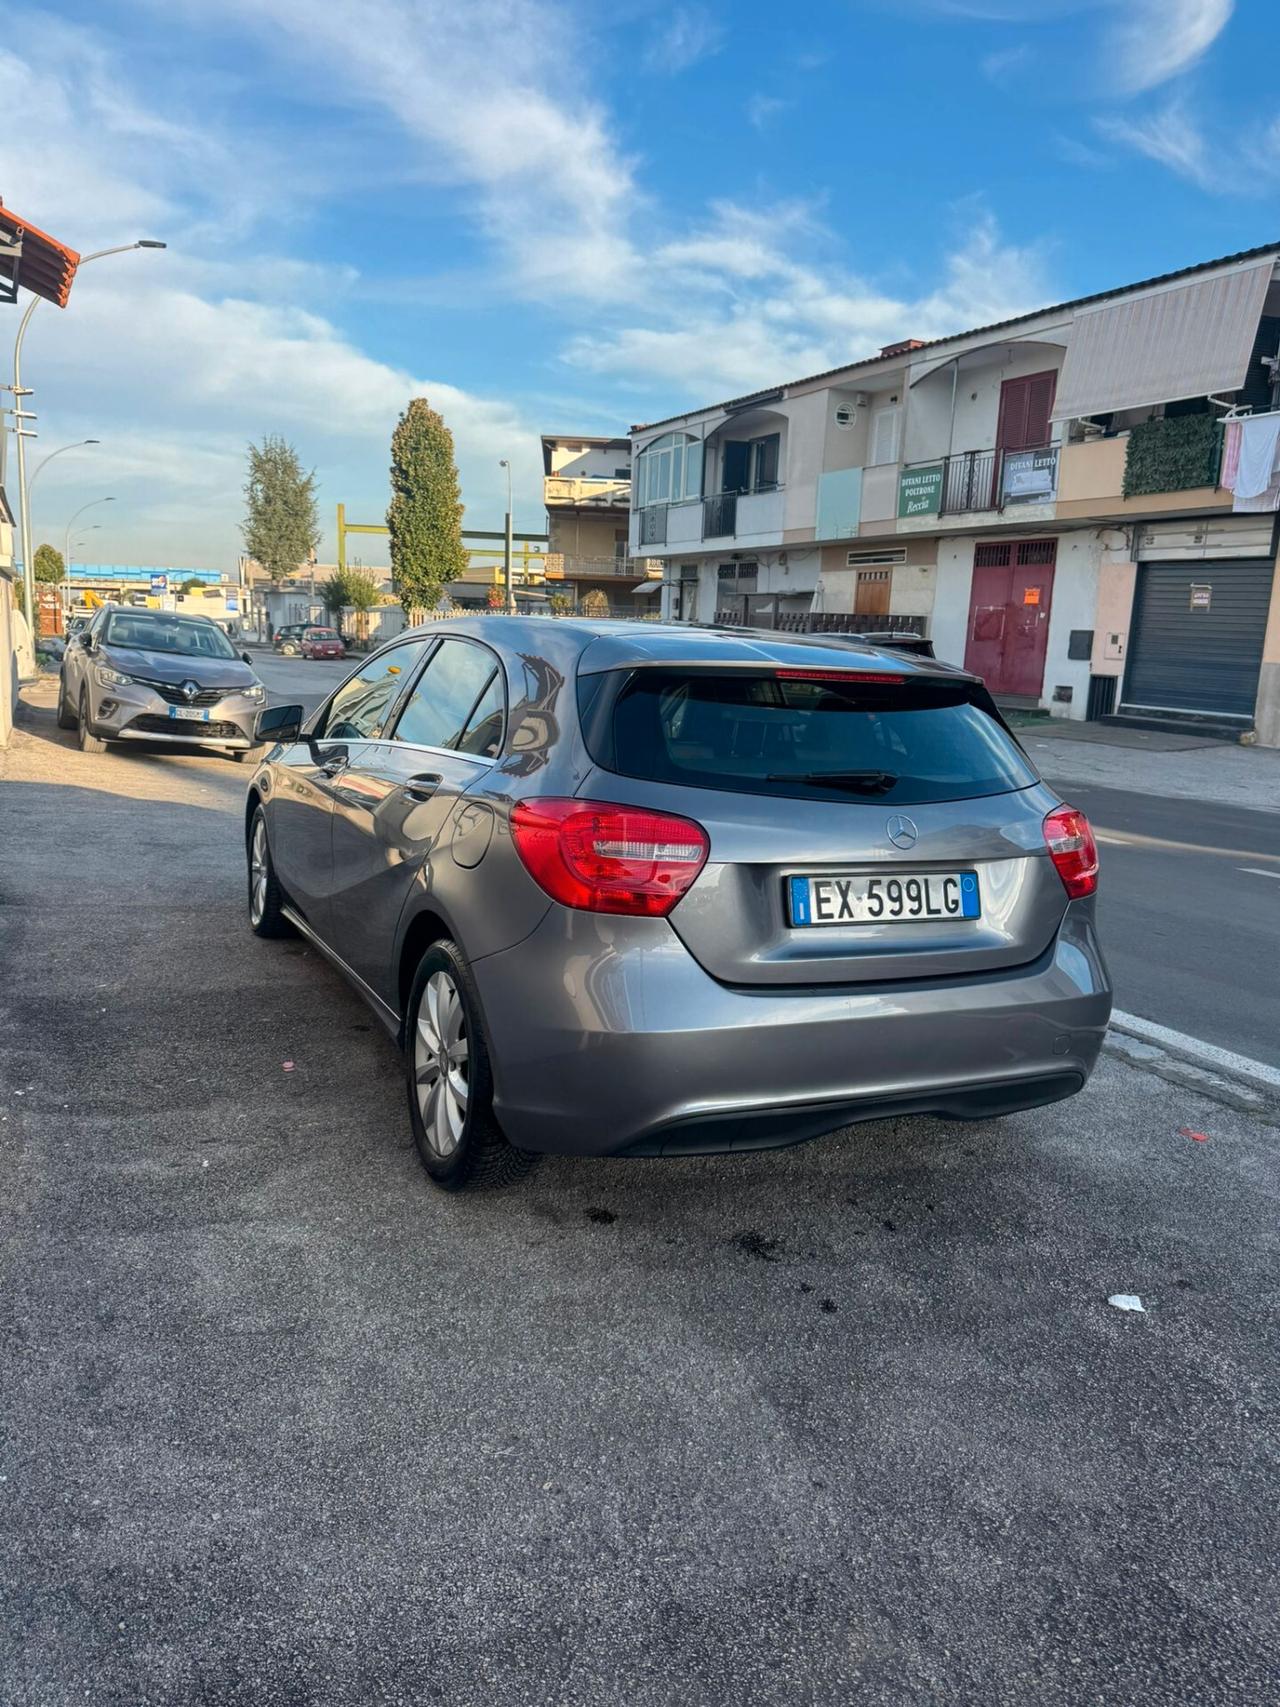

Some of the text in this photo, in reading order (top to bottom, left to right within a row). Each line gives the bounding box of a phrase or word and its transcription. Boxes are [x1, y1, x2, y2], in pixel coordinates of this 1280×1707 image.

[1034, 457, 1056, 468] LETTO
[922, 473, 941, 484] LETTO
[905, 485, 935, 497] POLTRONE
[814, 881, 854, 920] EX
[867, 878, 959, 917] 599LG
